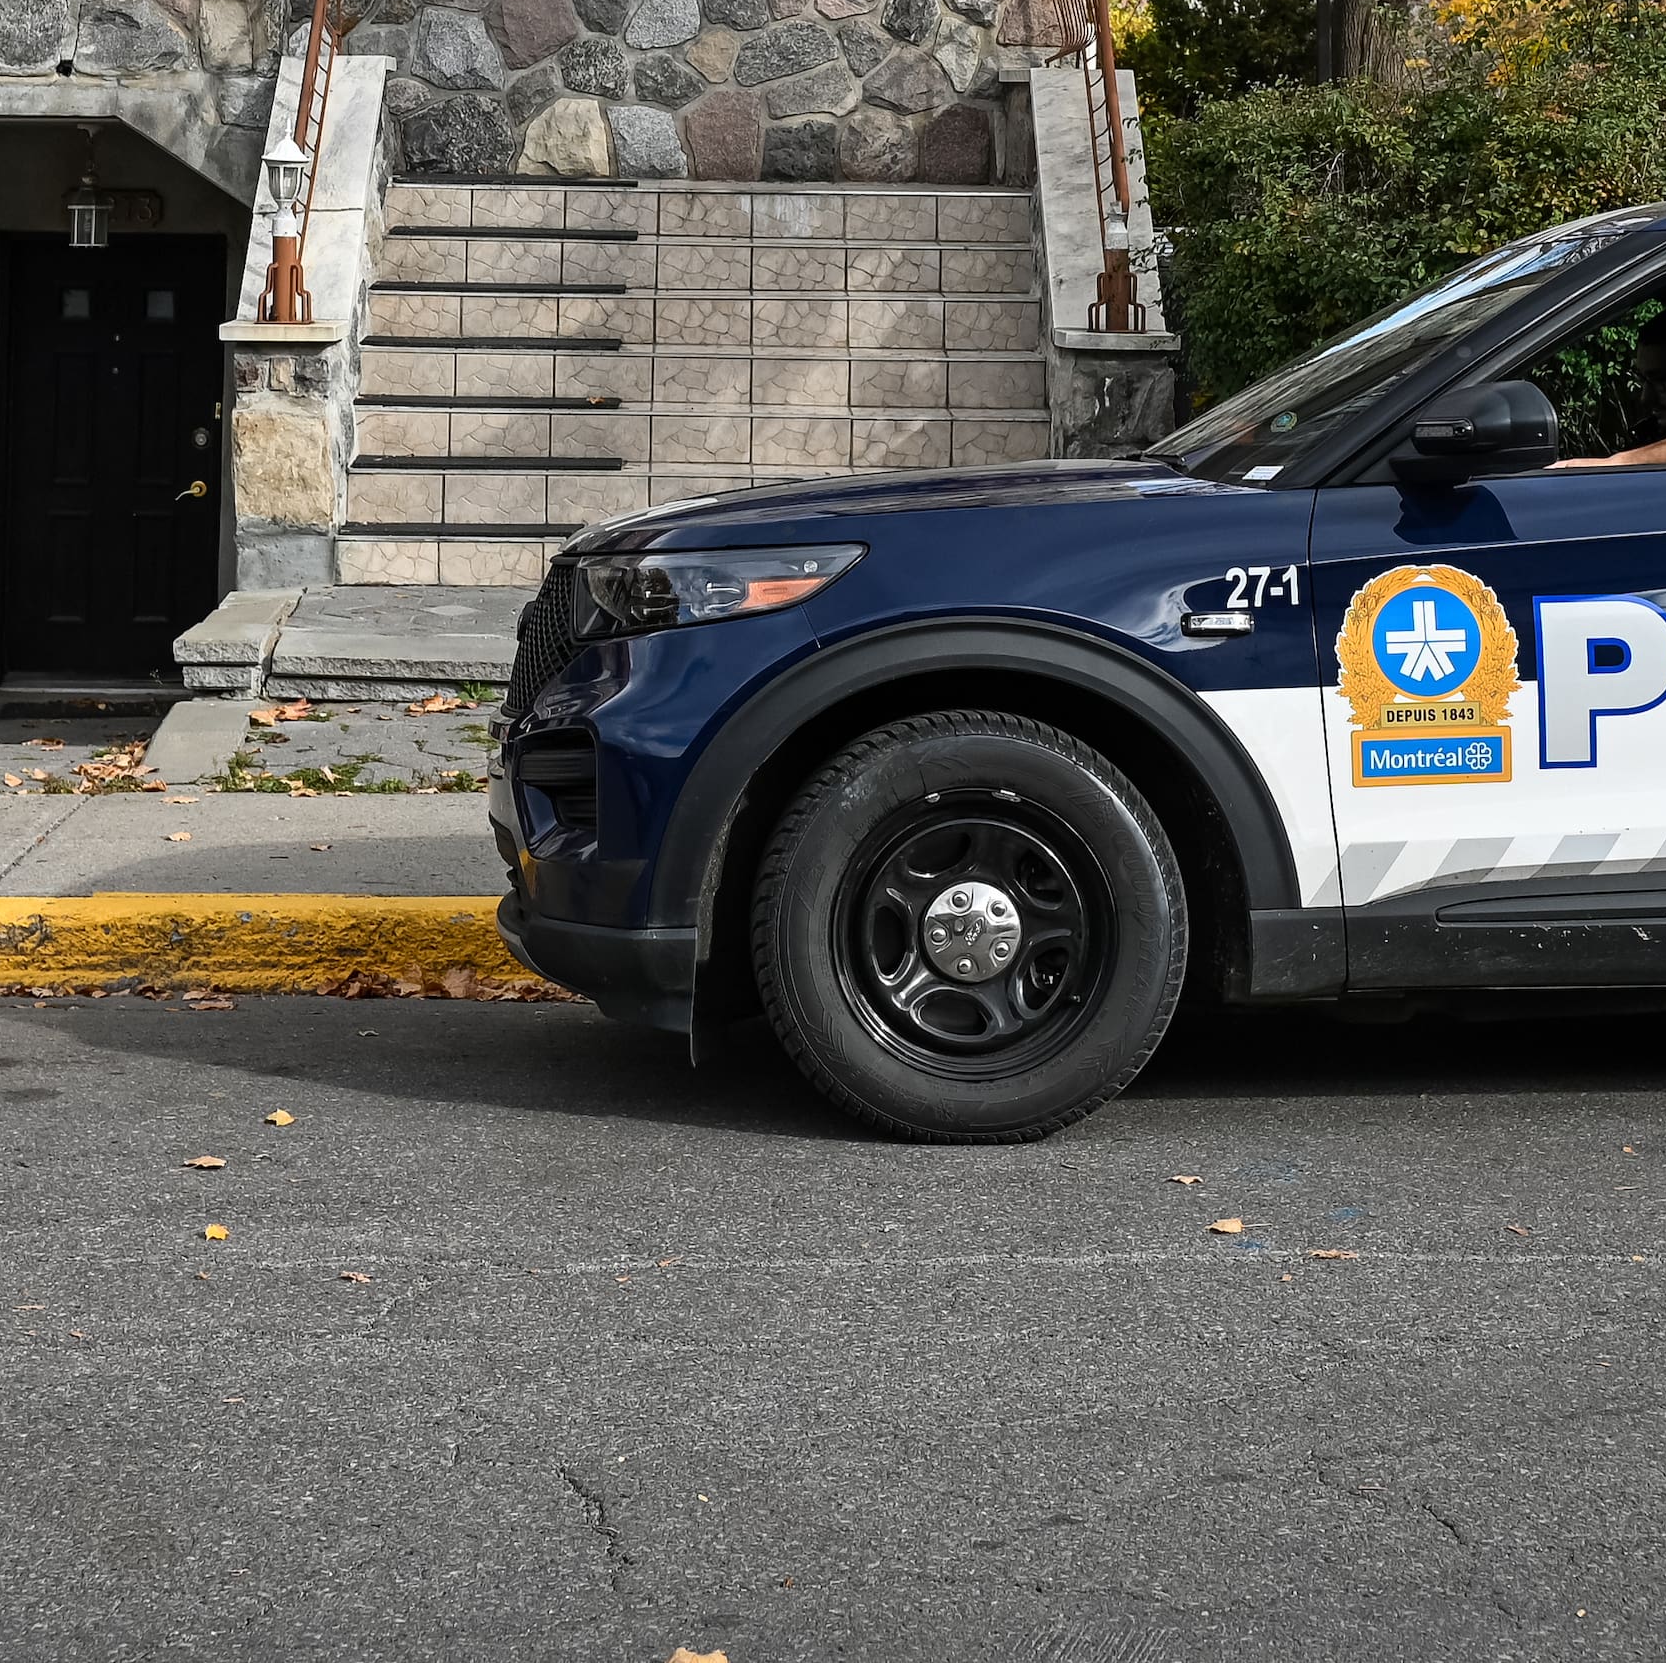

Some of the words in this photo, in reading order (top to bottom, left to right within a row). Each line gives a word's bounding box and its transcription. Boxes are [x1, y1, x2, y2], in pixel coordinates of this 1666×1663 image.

[1225, 564, 1300, 609] 27-1
[1386, 708, 1436, 723] DEPUIS
[1441, 707, 1475, 721] 1843
[1370, 746, 1463, 770] Montréal
